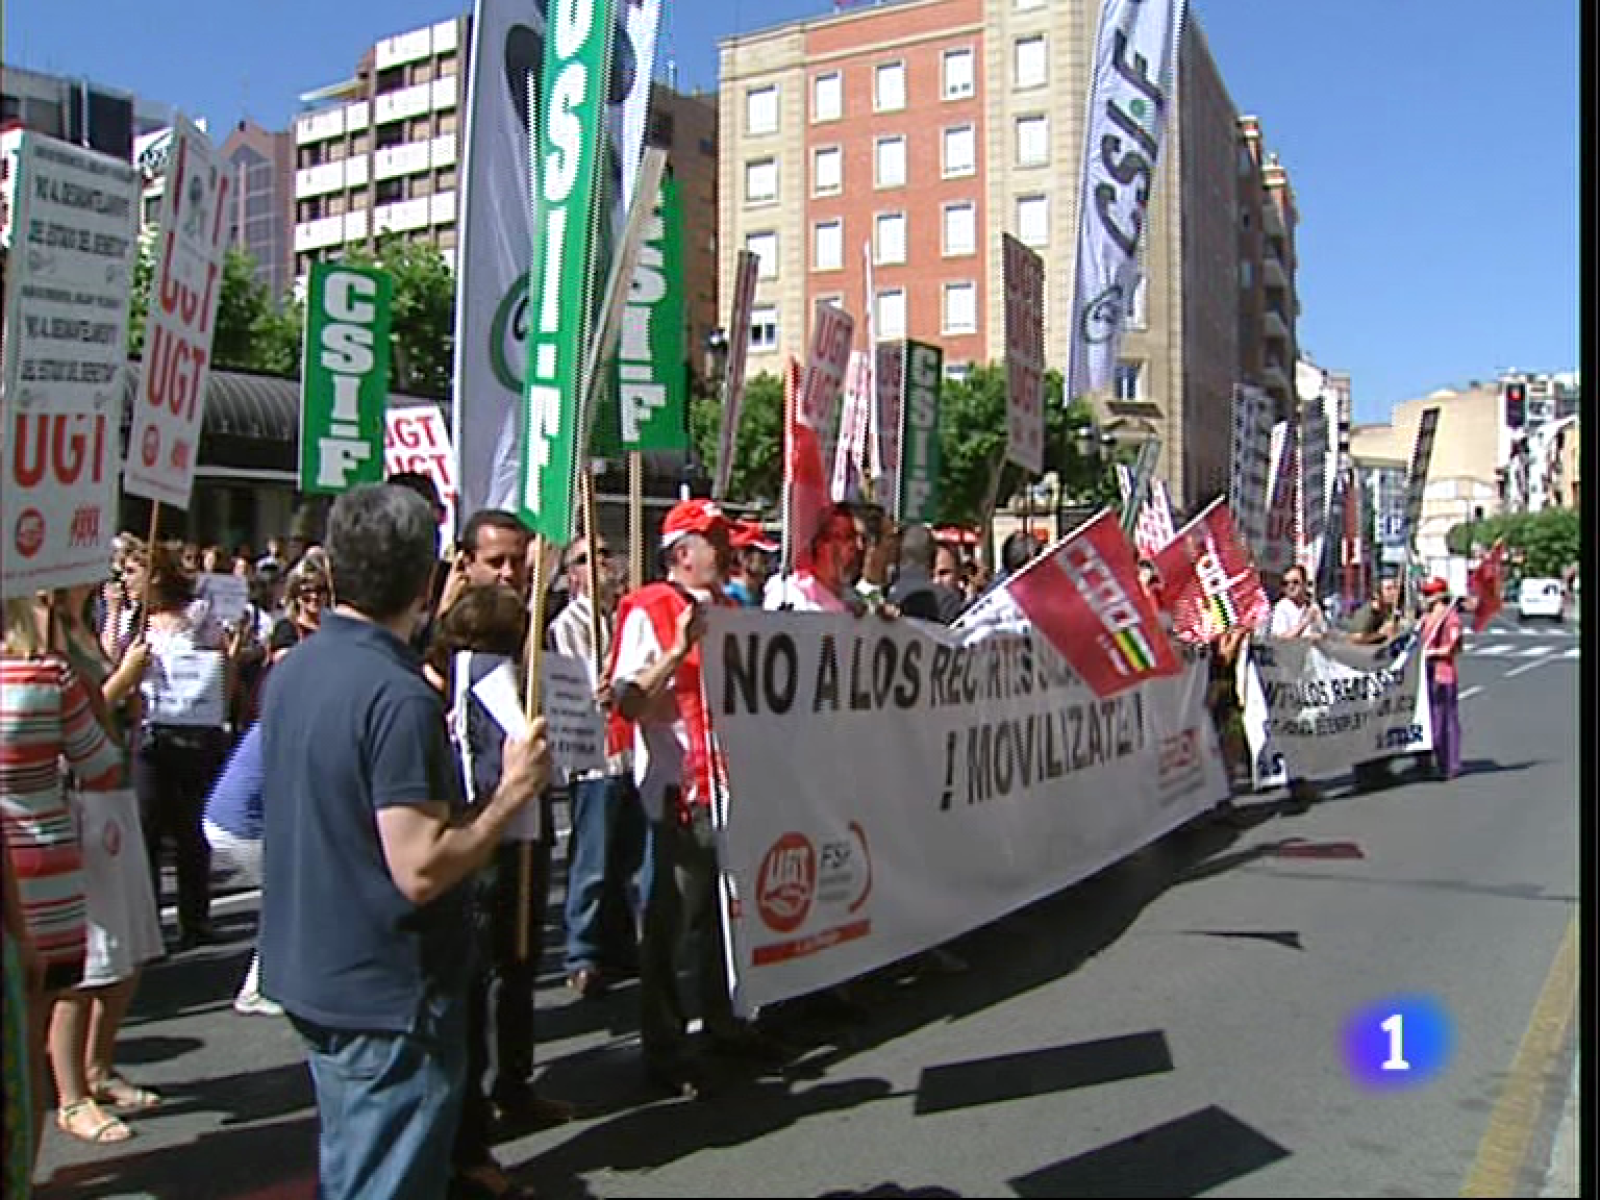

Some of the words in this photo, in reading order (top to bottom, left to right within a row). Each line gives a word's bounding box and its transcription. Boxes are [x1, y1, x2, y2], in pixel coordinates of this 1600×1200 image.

[146, 321, 206, 424] UGT
[316, 270, 378, 488] CSI-F
[13, 414, 105, 489] UGT
[723, 632, 800, 715] NO
[813, 633, 839, 714] A
[850, 636, 923, 710] LOS
[929, 632, 1034, 709] RECRTES
